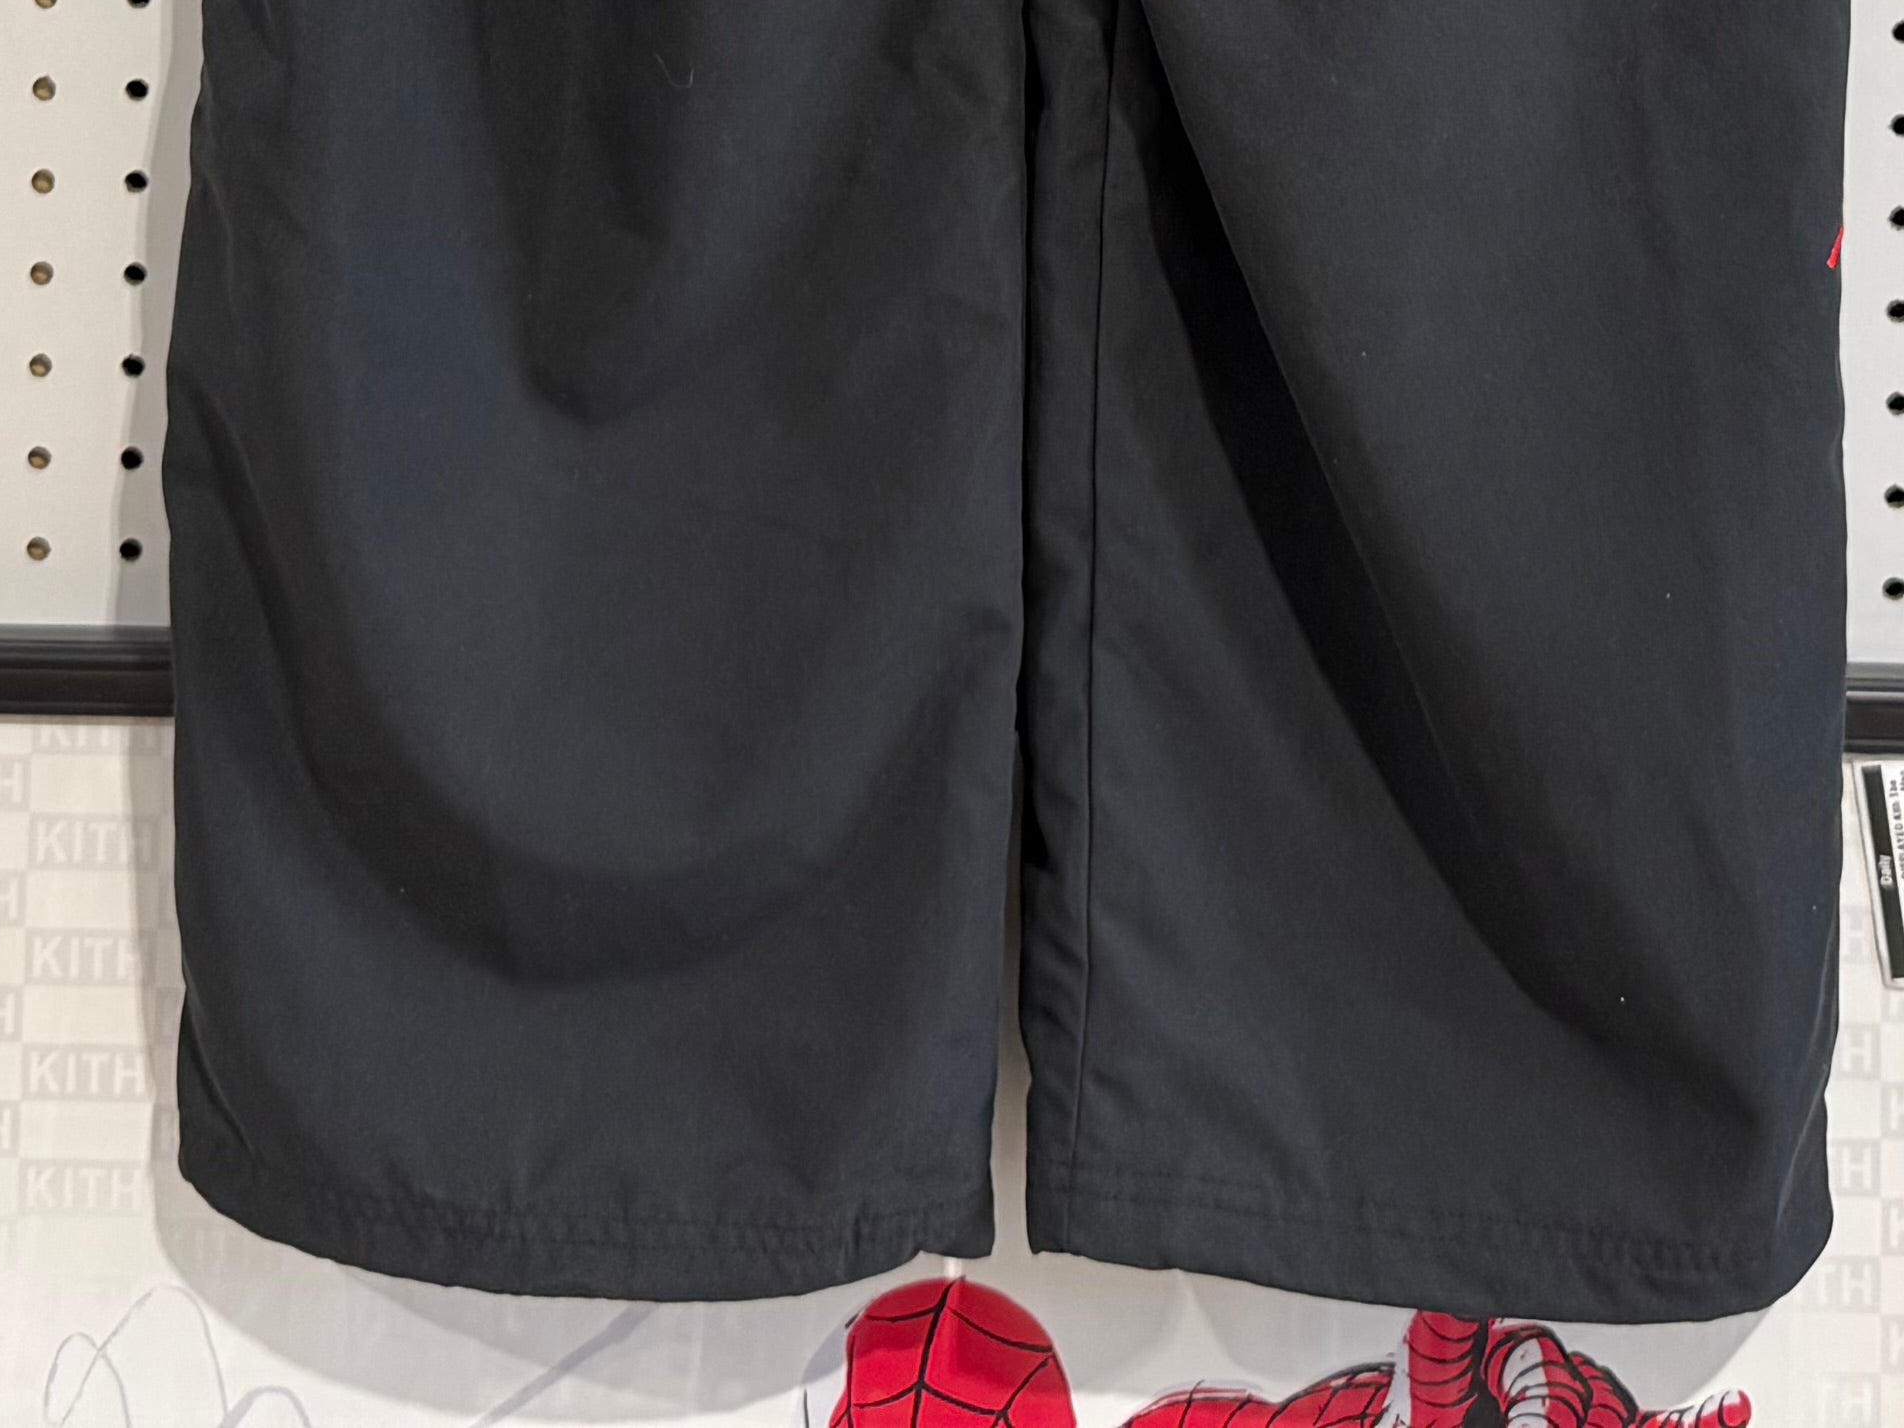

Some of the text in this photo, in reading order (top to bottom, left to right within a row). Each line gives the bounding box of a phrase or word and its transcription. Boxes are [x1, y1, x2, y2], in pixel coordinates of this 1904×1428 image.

[35, 819, 152, 864] KITH
[28, 1051, 146, 1095] KITH
[25, 1166, 143, 1210] KITH
